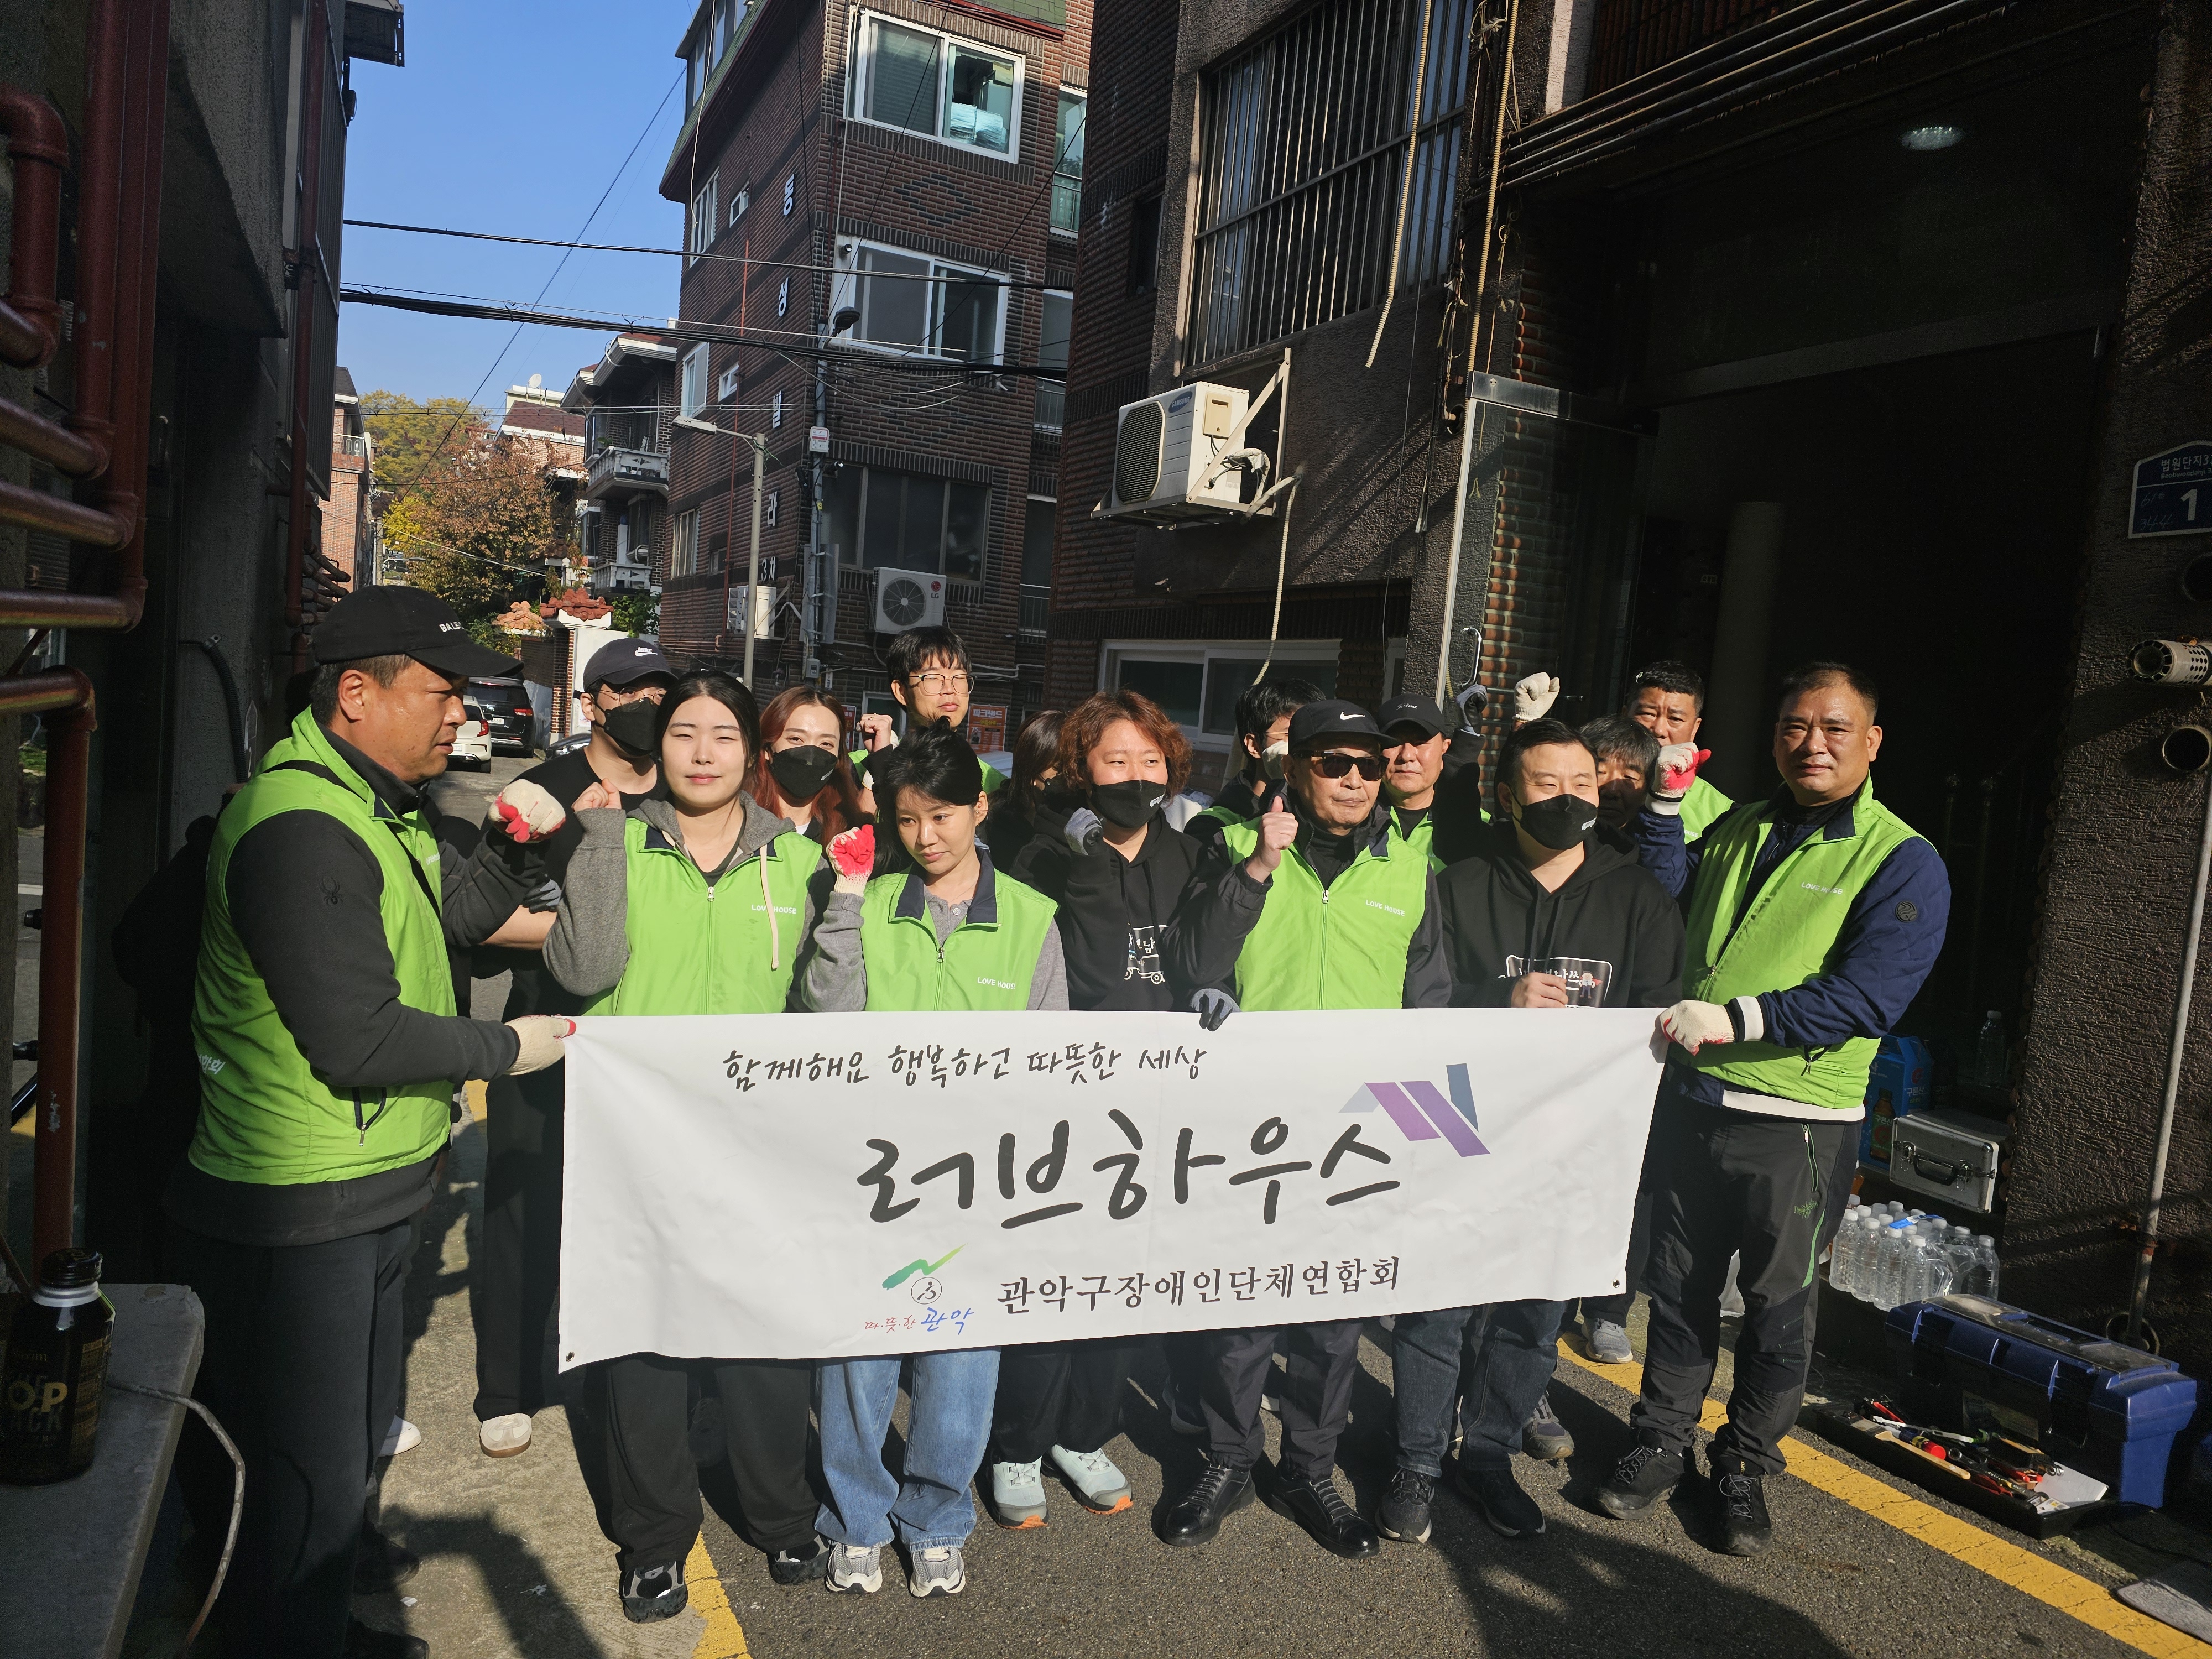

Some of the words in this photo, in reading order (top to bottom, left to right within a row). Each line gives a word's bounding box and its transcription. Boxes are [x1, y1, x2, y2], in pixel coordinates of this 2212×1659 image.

[2161, 454, 2212, 472] 법원단지3
[973, 708, 1003, 719] 파크랜드
[1684, 830, 1698, 838] OUSE
[1801, 881, 1820, 891] LOVE
[773, 906, 797, 914] HOUSE
[1365, 899, 1383, 909] LOVE
[1384, 904, 1405, 916] HOUSE
[977, 976, 996, 986] LOVE
[722, 1050, 869, 1092] 함께해요
[888, 1044, 1010, 1088] 행복하고
[1027, 1041, 1122, 1084] 따뜻한
[1138, 1045, 1207, 1080] 세상
[857, 1109, 1401, 1229] 러브하우스
[997, 1256, 1400, 1315] 관악구장애인단체연합회
[920, 1307, 975, 1335] 관악
